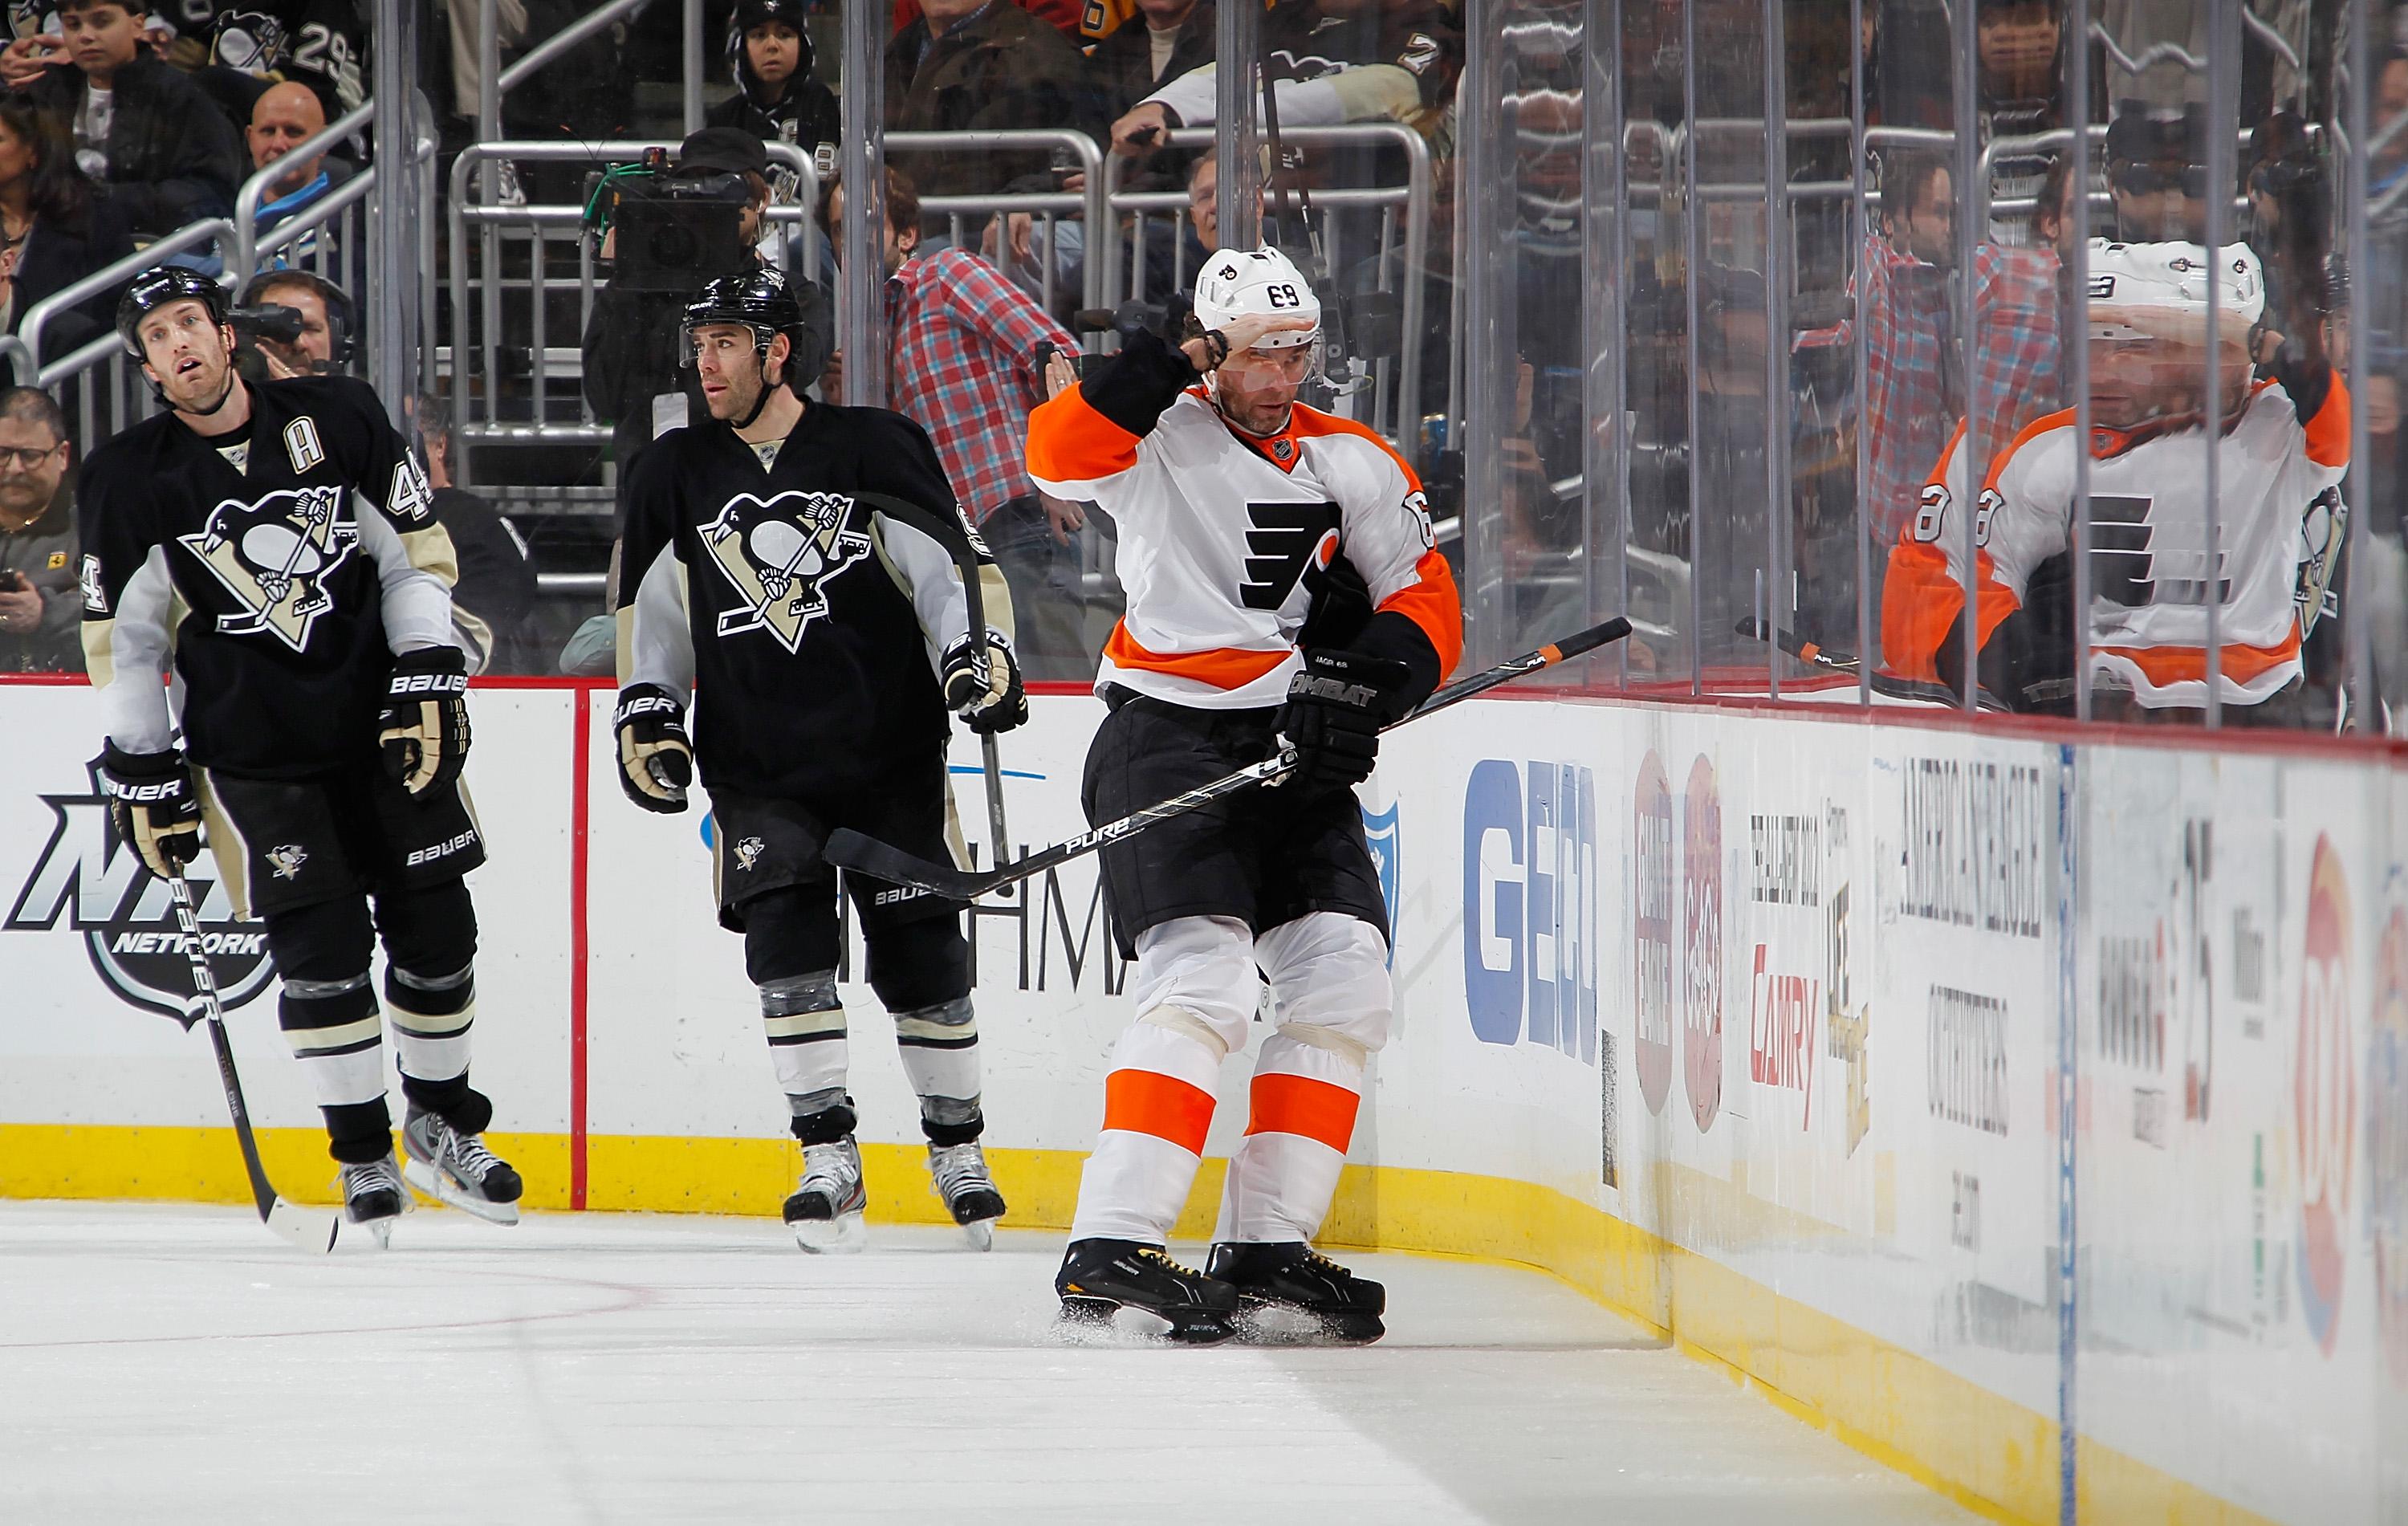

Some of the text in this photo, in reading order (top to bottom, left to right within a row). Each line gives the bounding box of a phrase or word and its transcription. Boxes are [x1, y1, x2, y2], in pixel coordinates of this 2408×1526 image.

[284, 416, 325, 474] A
[1527, 655, 1546, 668] PUR
[1289, 674, 1377, 707] OMBAT
[406, 829, 475, 866] BAUER
[1638, 812, 1670, 922] GIANT
[1462, 759, 1597, 1068] GEICO
[111, 932, 270, 955] NETWORK
